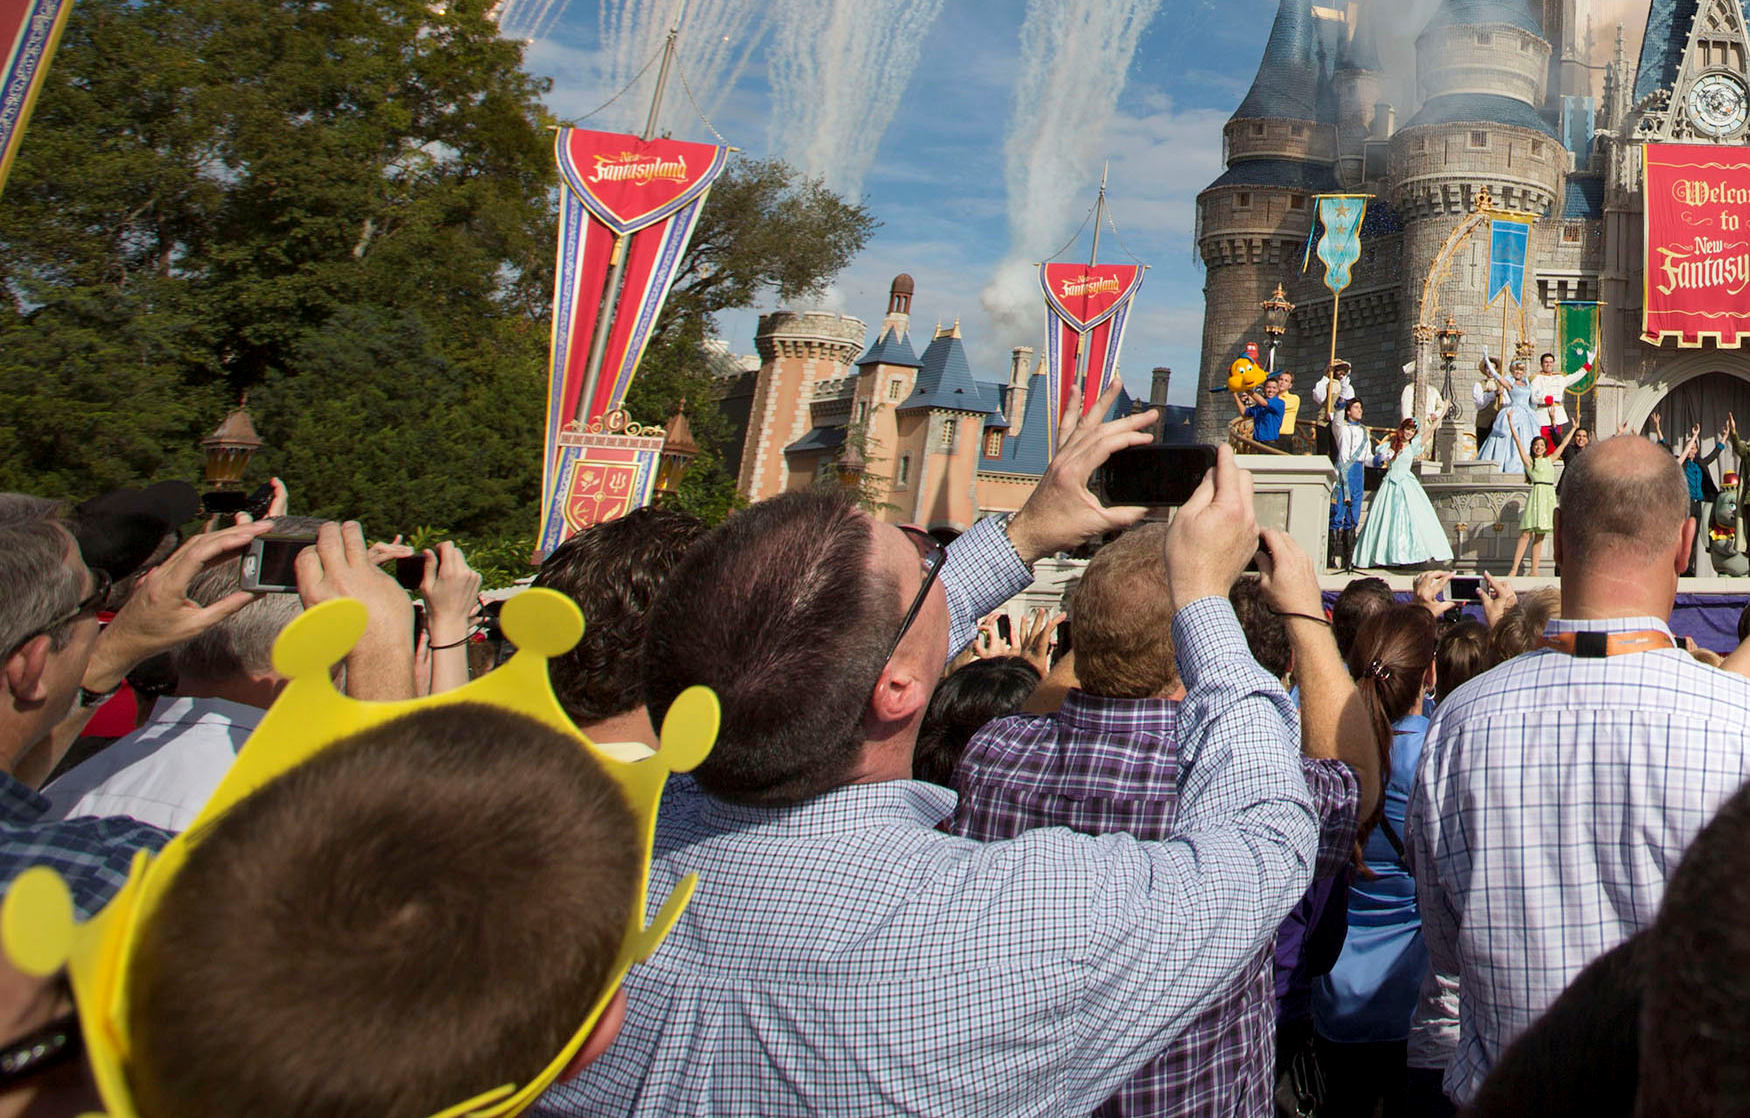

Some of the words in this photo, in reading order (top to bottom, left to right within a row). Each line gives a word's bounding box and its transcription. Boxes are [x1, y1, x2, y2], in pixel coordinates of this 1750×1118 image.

[588, 155, 687, 186] Fantasyland
[1720, 210, 1739, 231] to
[1694, 236, 1723, 254] New
